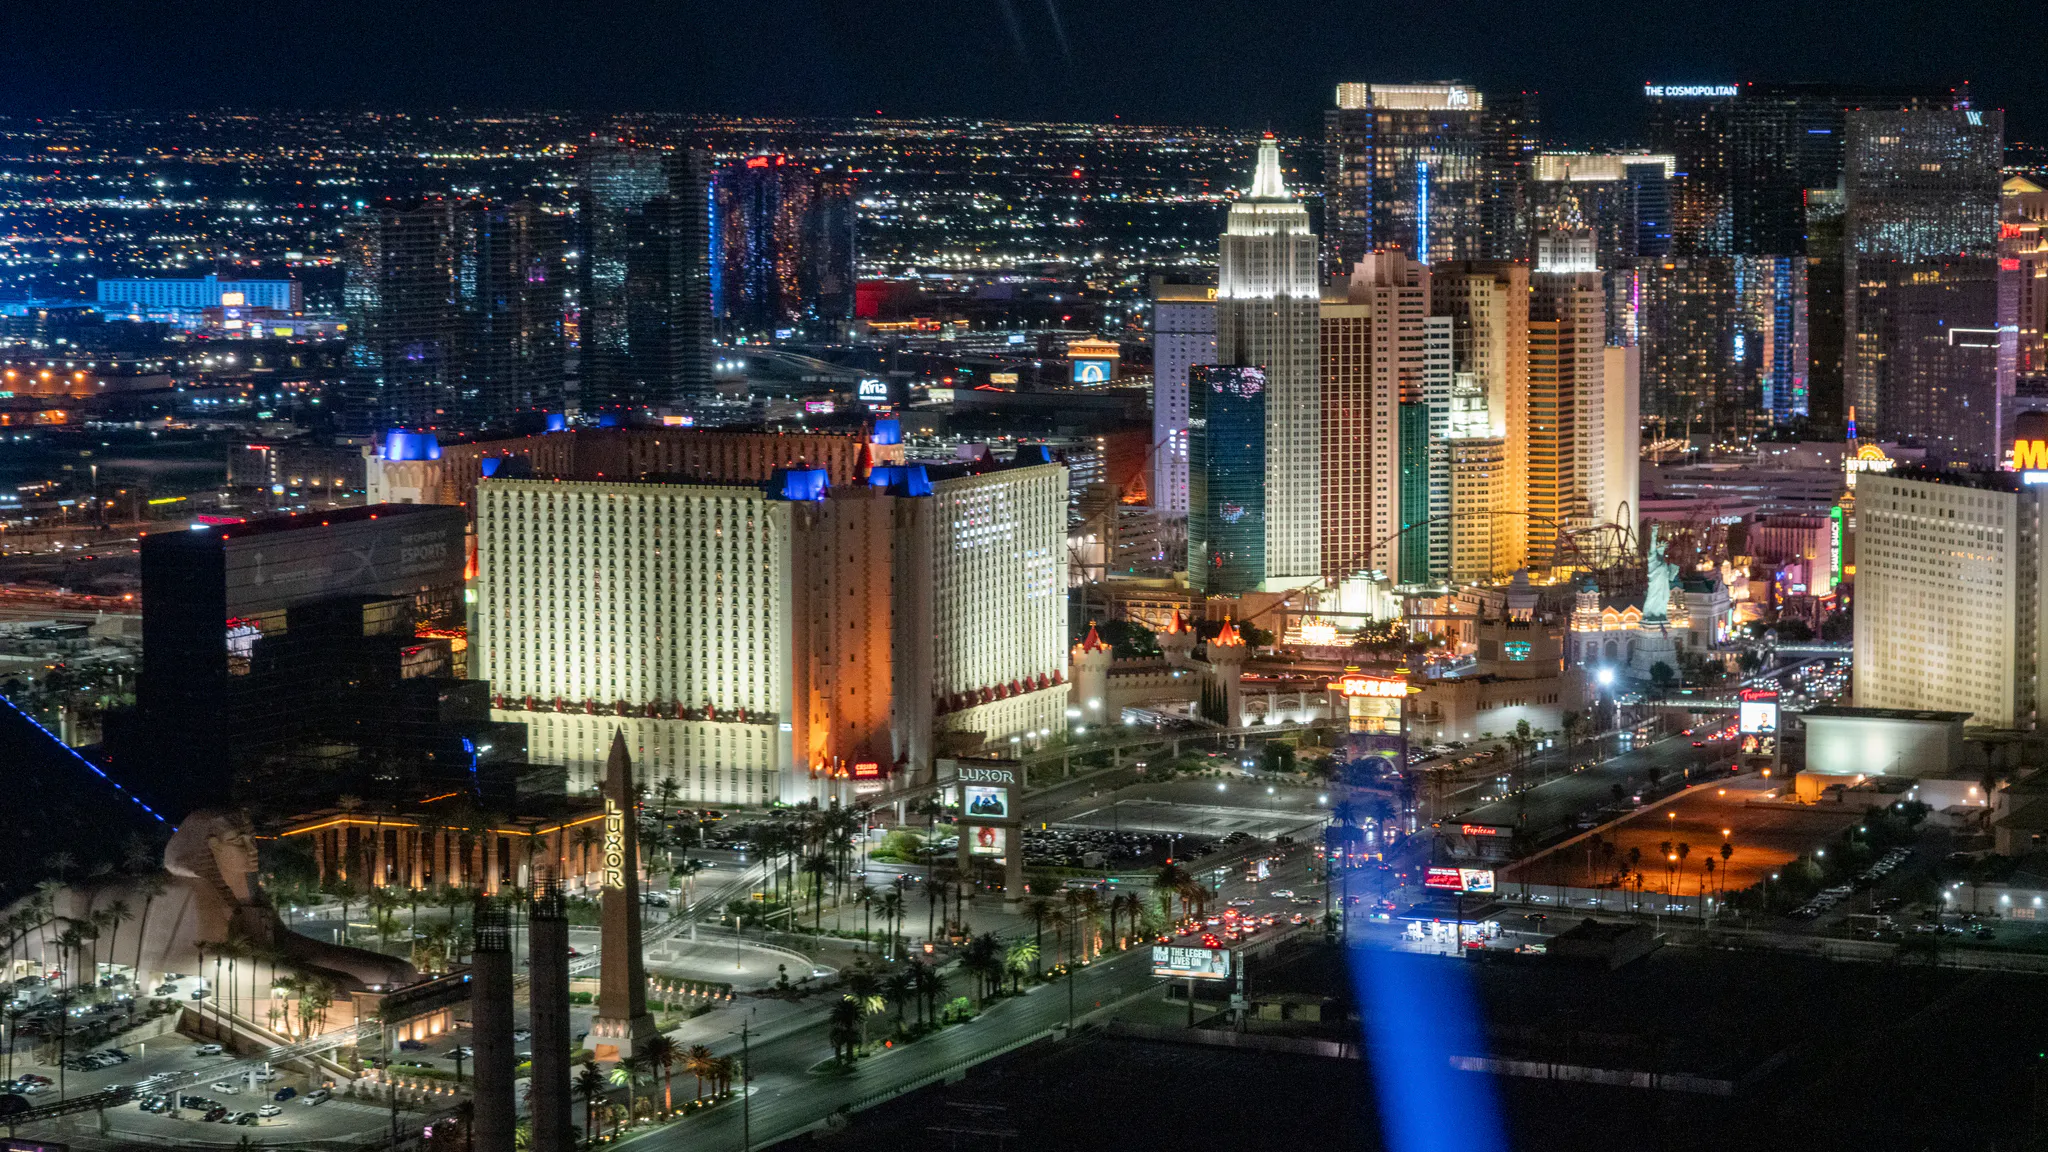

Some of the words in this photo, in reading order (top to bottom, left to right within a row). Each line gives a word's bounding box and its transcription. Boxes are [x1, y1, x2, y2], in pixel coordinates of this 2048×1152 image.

[1447, 86, 1469, 106] Aria
[1644, 85, 1664, 96] THE
[1665, 86, 1738, 96] COSMOPOLITAN
[859, 379, 888, 395] Aria
[2013, 439, 2048, 470] M
[1830, 521, 1839, 547] SHACK
[401, 542, 447, 563] ESPORTS
[1830, 547, 1839, 572] SHAKE
[957, 767, 1015, 784] LUXOR
[1461, 824, 1497, 836] Tropicana
[604, 799, 625, 889] LUXOR
[1170, 947, 1185, 957] THE
[1185, 948, 1213, 960] LEGEND
[1170, 956, 1191, 966] LIVES
[1191, 957, 1202, 967] ON
